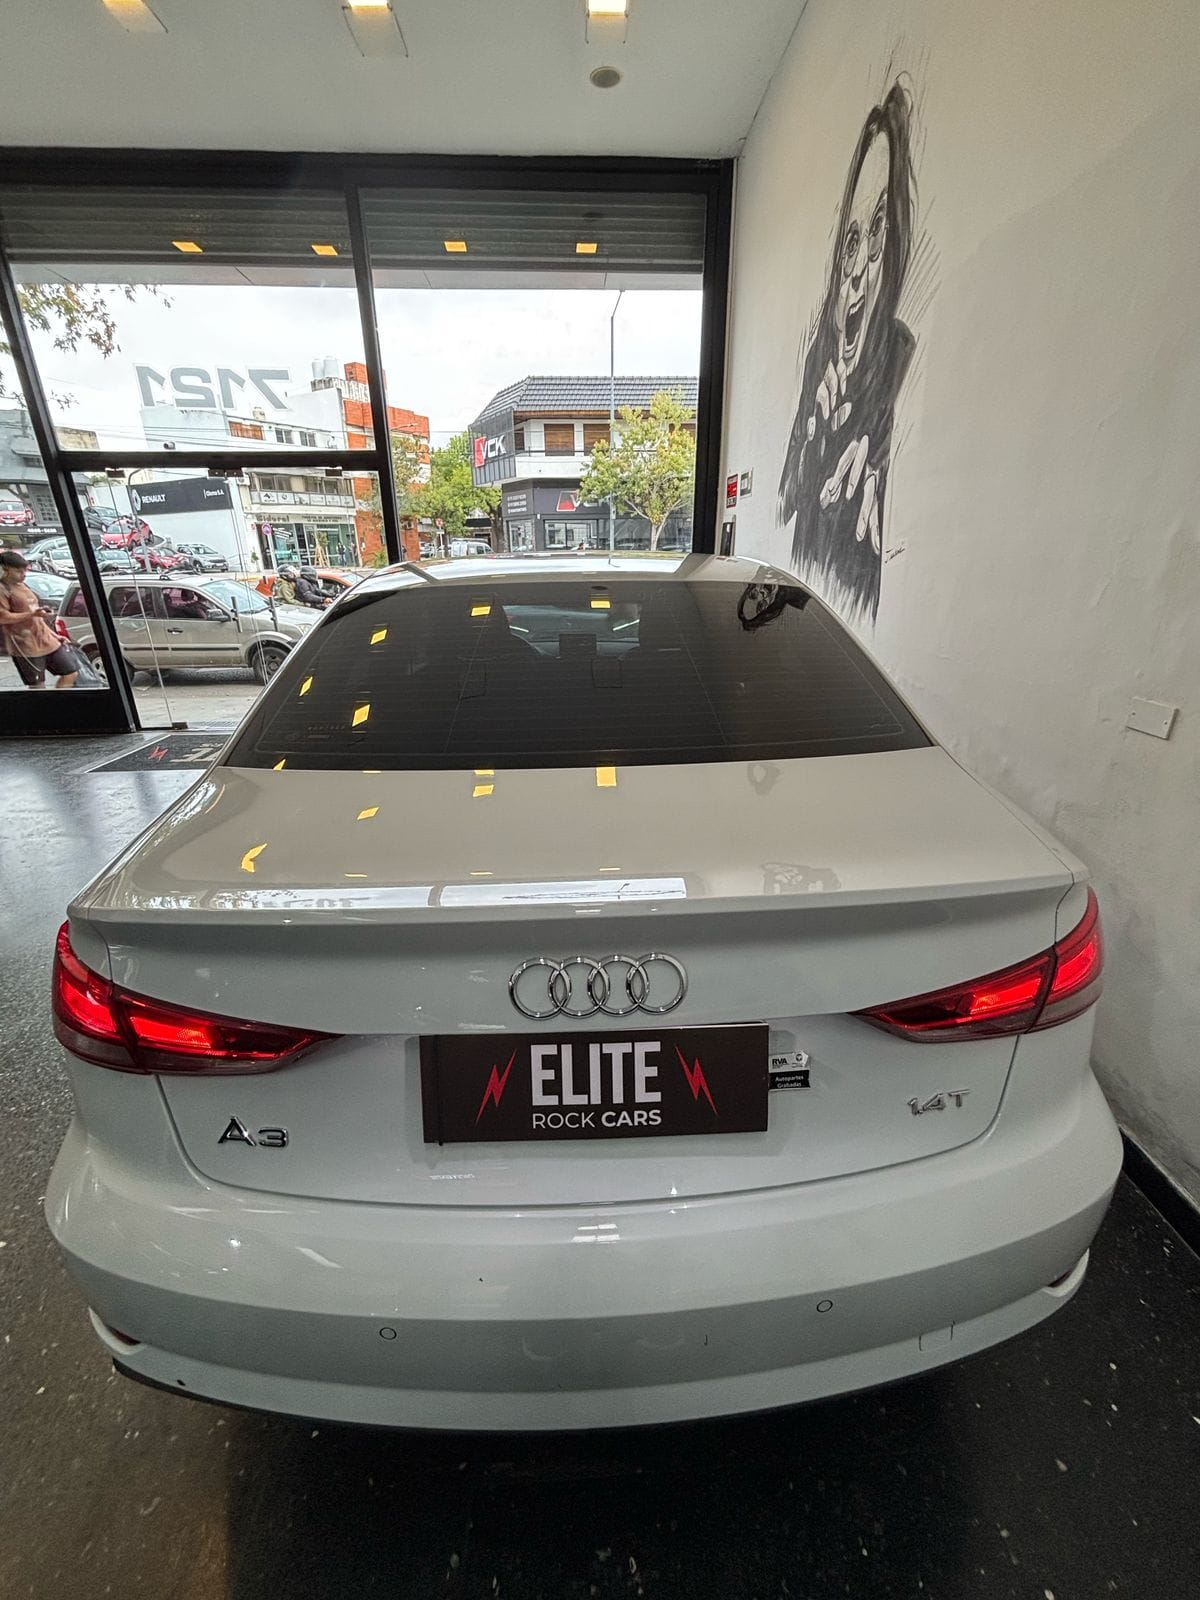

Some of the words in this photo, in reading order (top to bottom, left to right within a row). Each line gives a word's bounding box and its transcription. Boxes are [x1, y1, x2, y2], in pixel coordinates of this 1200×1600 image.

[142, 494, 166, 504] RENAULT
[772, 1057, 788, 1065] RVA
[530, 1041, 662, 1106] ELITE
[533, 1111, 595, 1129] ROCK
[600, 1109, 662, 1128] CARS
[217, 1115, 289, 1148] A3
